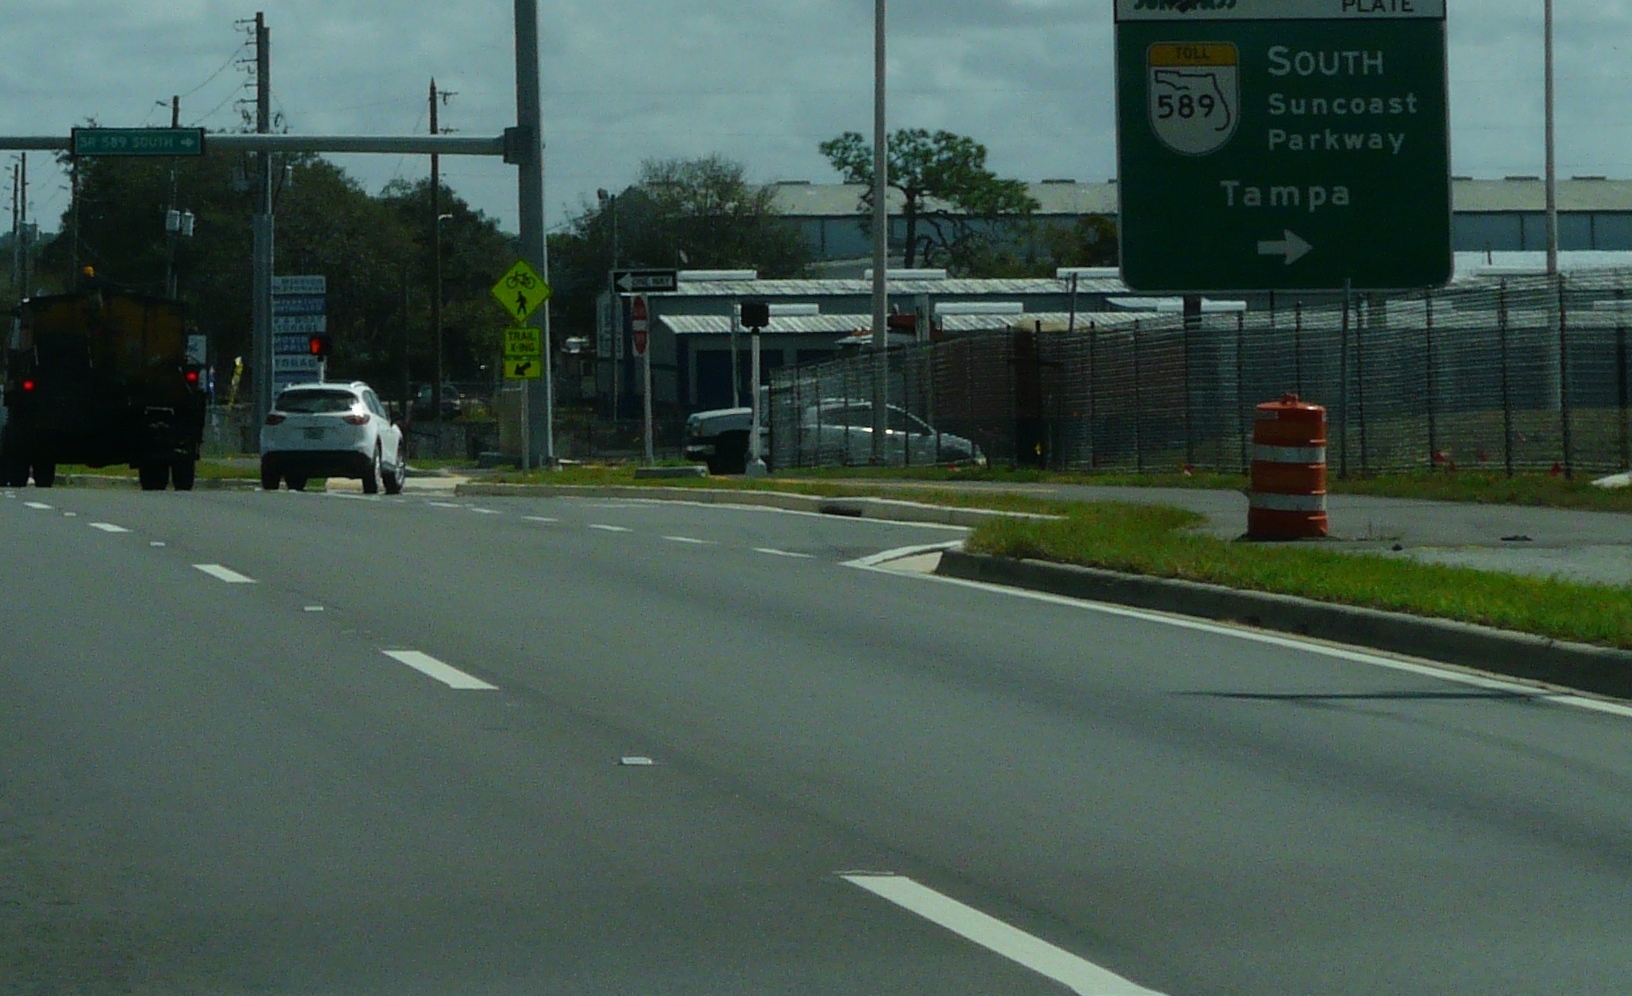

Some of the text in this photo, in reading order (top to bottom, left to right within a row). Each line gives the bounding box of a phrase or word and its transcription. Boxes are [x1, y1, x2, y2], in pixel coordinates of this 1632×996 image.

[1176, 46, 1211, 60] TOLL
[1157, 94, 1215, 119] 589
[1268, 92, 1418, 115] Suncoast
[1268, 129, 1406, 154] Parkway
[1220, 180, 1350, 212] Tampa
[508, 331, 537, 341] TRAIL
